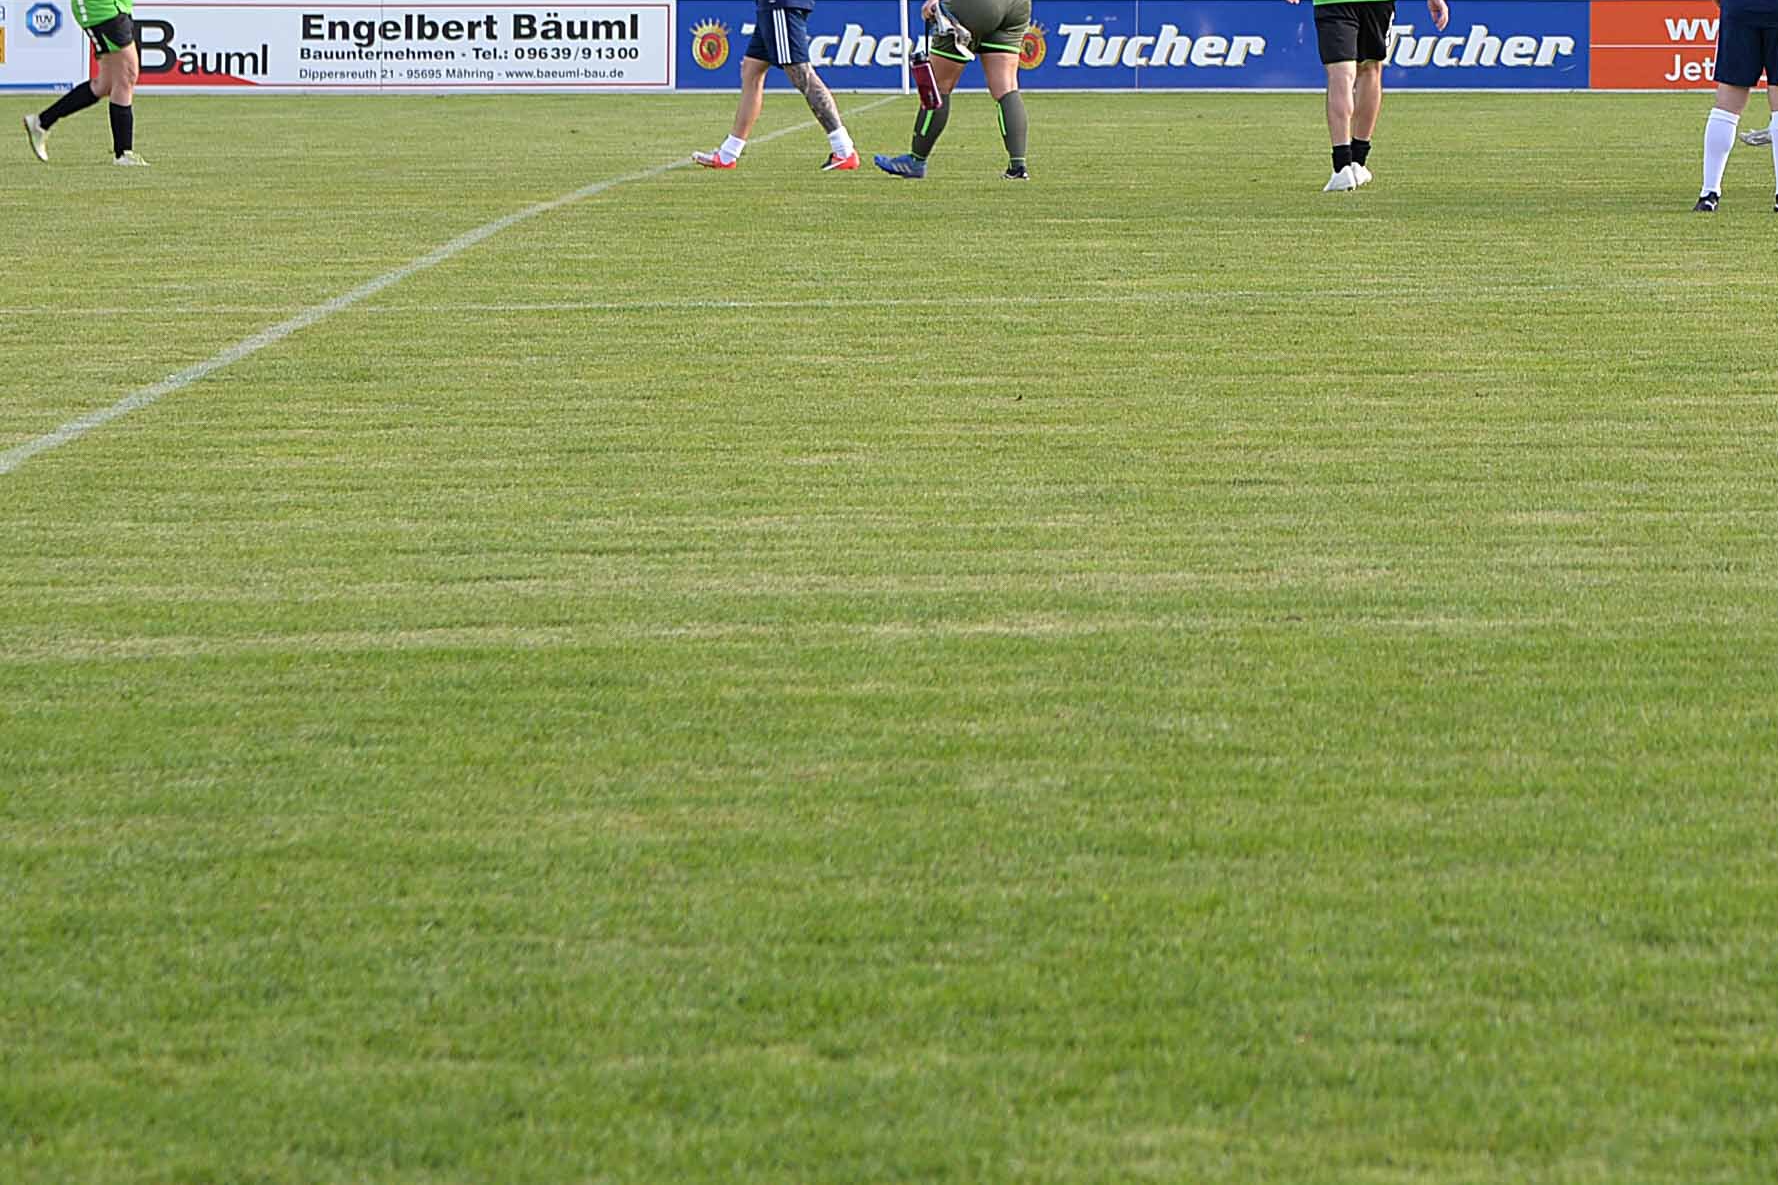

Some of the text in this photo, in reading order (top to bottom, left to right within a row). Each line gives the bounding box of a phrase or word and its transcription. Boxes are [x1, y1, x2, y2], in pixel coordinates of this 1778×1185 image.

[136, 19, 268, 75] Bäuml
[302, 12, 639, 47] Engelbert Bäuml
[1057, 23, 1266, 67] Tucher
[1383, 24, 1575, 67] Tucher
[300, 47, 455, 60] Bauunternehmen
[472, 47, 508, 60] Tel.:
[299, 68, 377, 81] Dippersreuth
[381, 68, 394, 79] 21
[406, 68, 442, 79] 95695
[446, 67, 494, 80] Mähring
[505, 68, 625, 79] www.baeuml-bau.de
